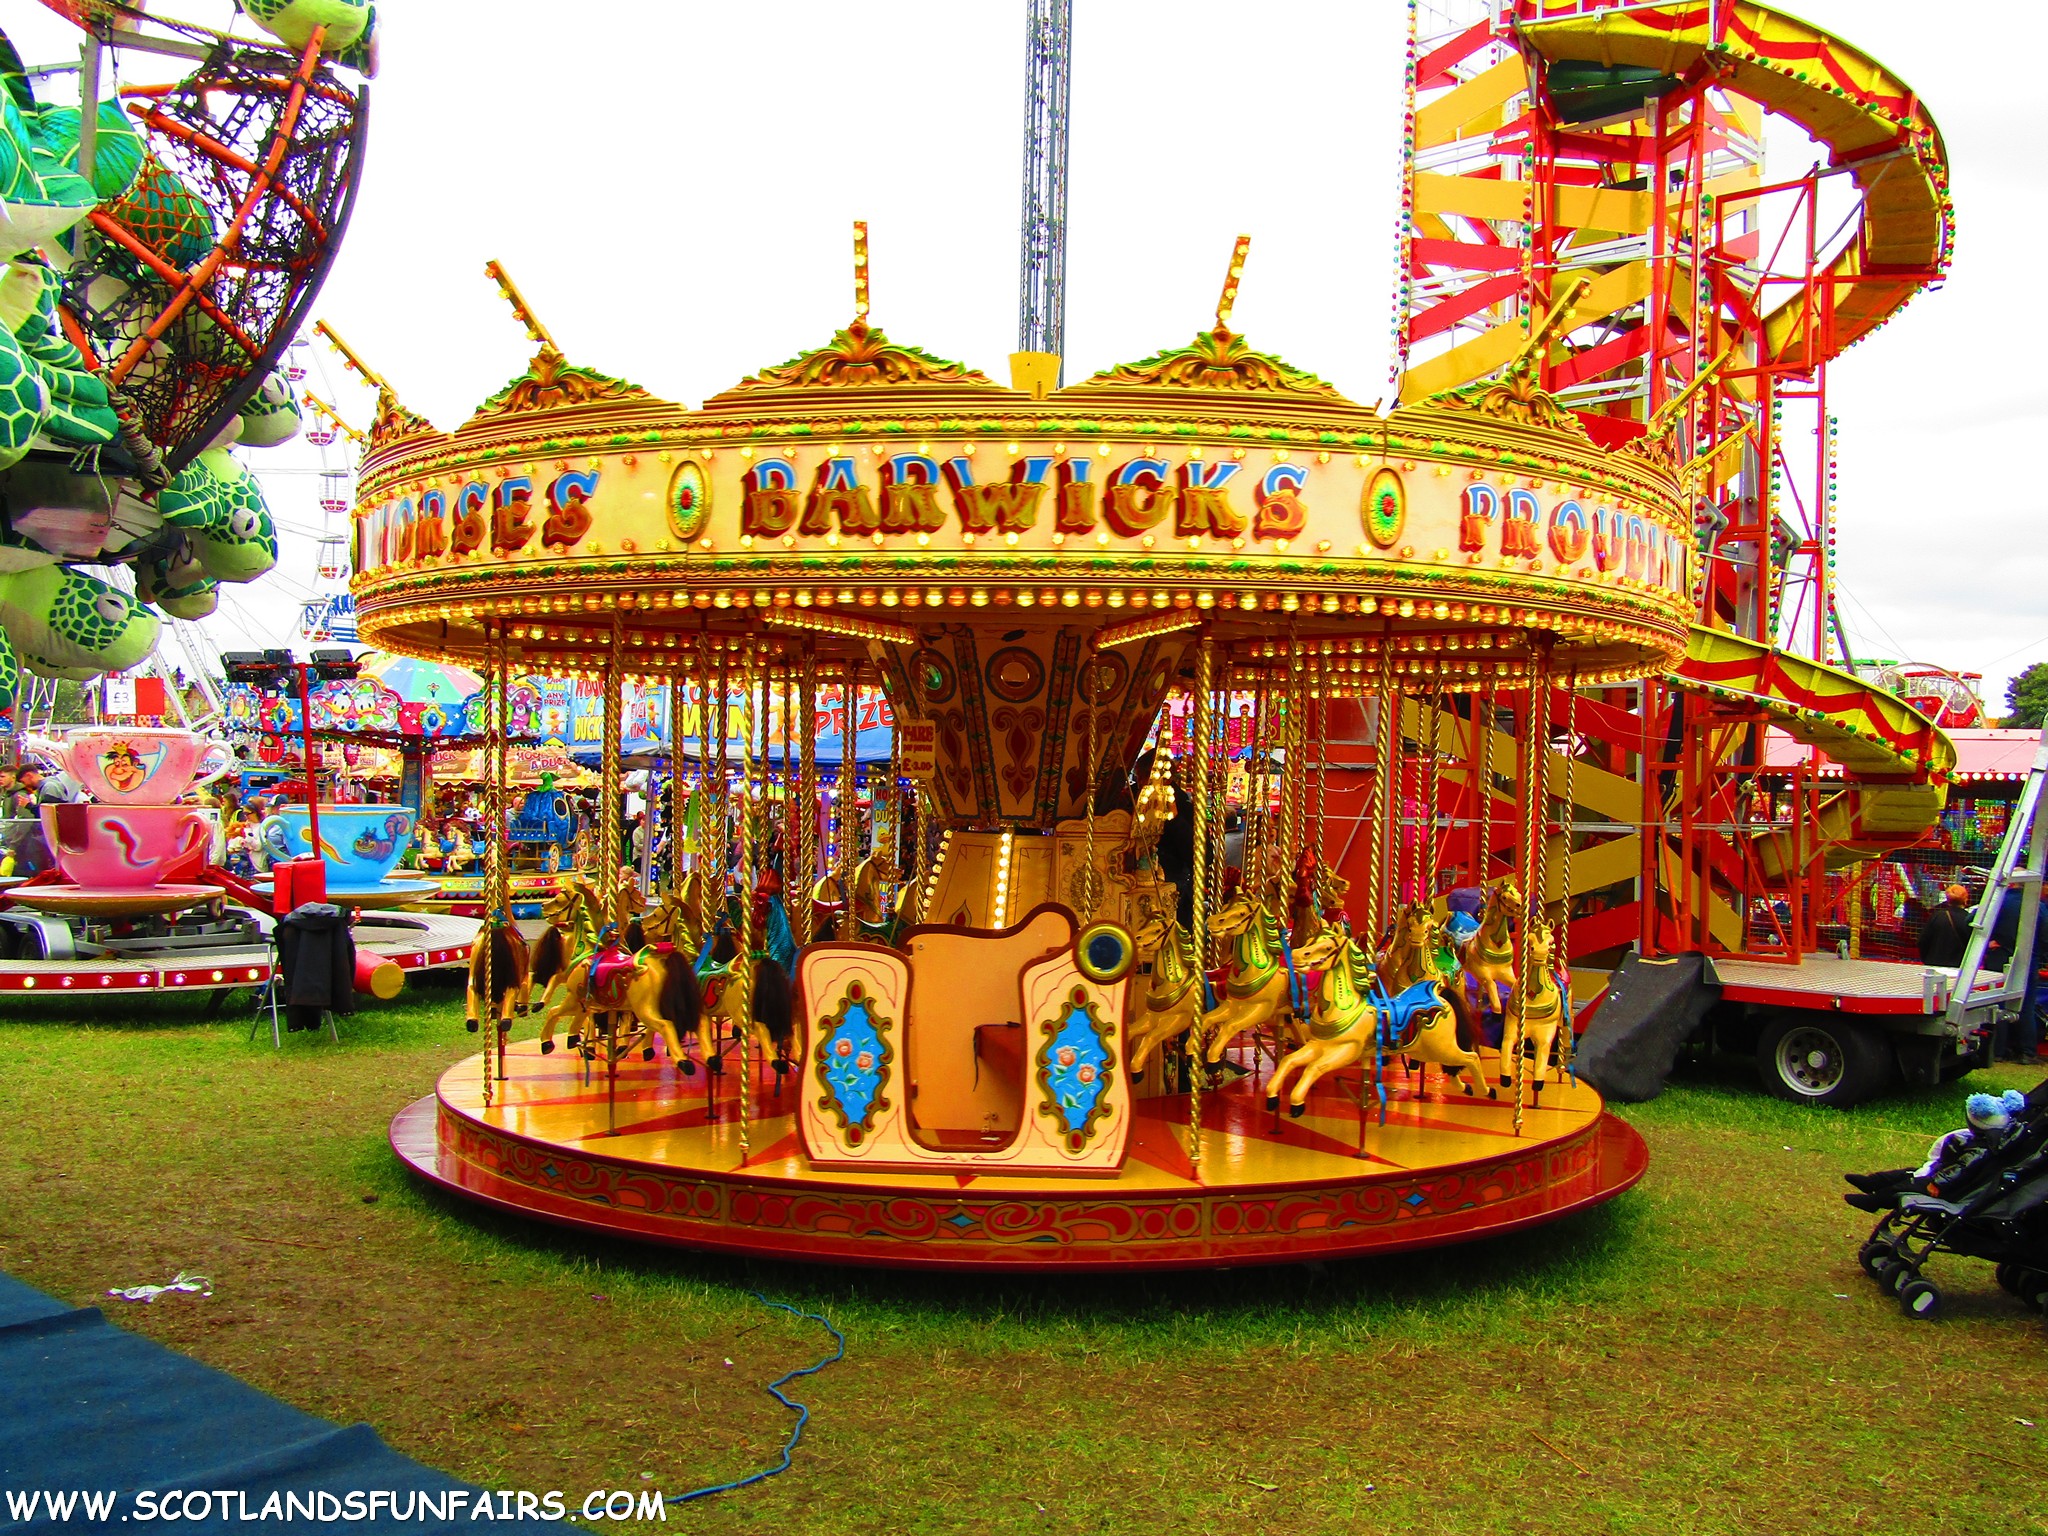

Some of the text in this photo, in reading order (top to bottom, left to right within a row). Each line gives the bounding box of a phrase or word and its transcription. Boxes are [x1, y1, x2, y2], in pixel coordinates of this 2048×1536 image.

[741, 452, 1308, 544] BARWICKS
[114, 692, 130, 703] £3
[813, 700, 895, 737] PRZE
[903, 725, 934, 742] FARE
[530, 760, 540, 770] A
